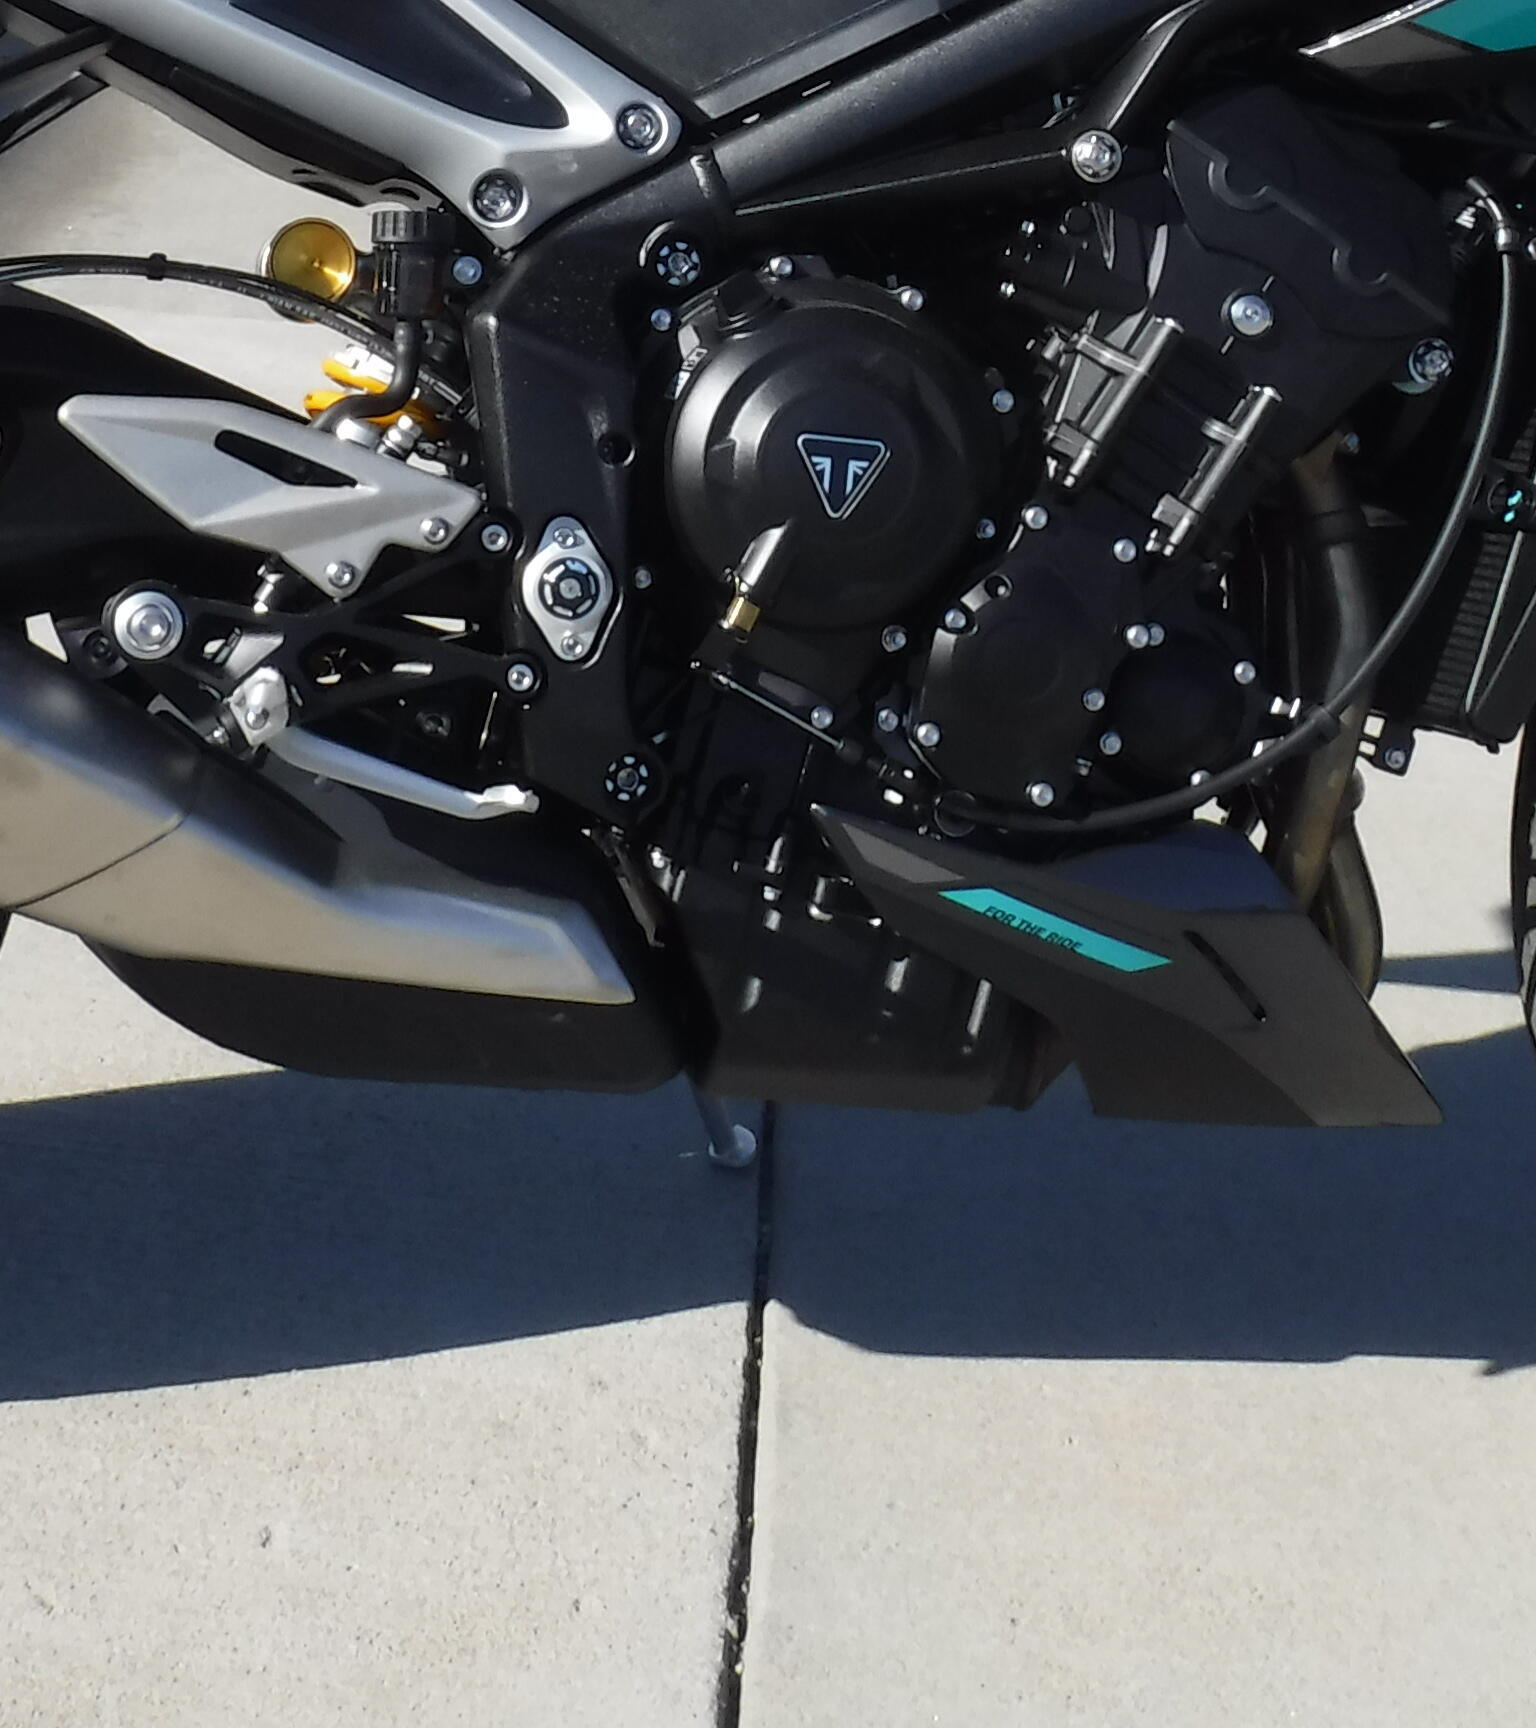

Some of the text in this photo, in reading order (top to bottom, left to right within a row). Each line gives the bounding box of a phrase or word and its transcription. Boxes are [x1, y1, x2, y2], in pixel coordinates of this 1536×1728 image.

[984, 905, 1083, 953] FOR THE RIDE
